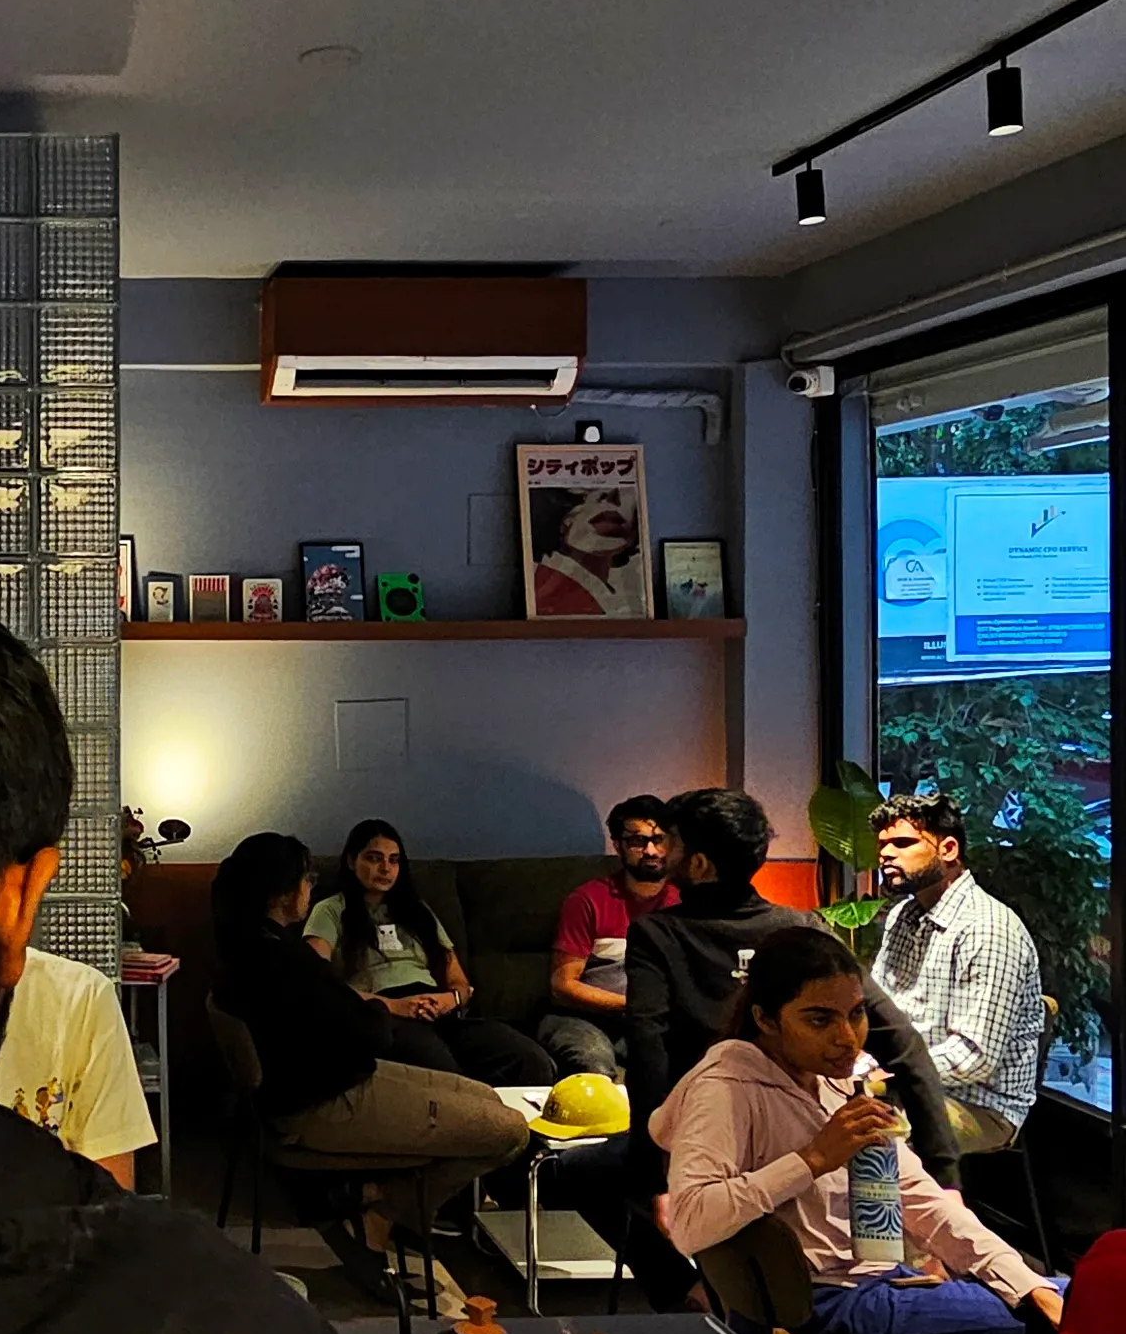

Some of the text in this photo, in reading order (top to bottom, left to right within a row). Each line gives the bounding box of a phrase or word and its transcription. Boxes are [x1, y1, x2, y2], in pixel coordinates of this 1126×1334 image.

[527, 455, 636, 476] シティポップ
[1008, 546, 1042, 554] DYNAMIC
